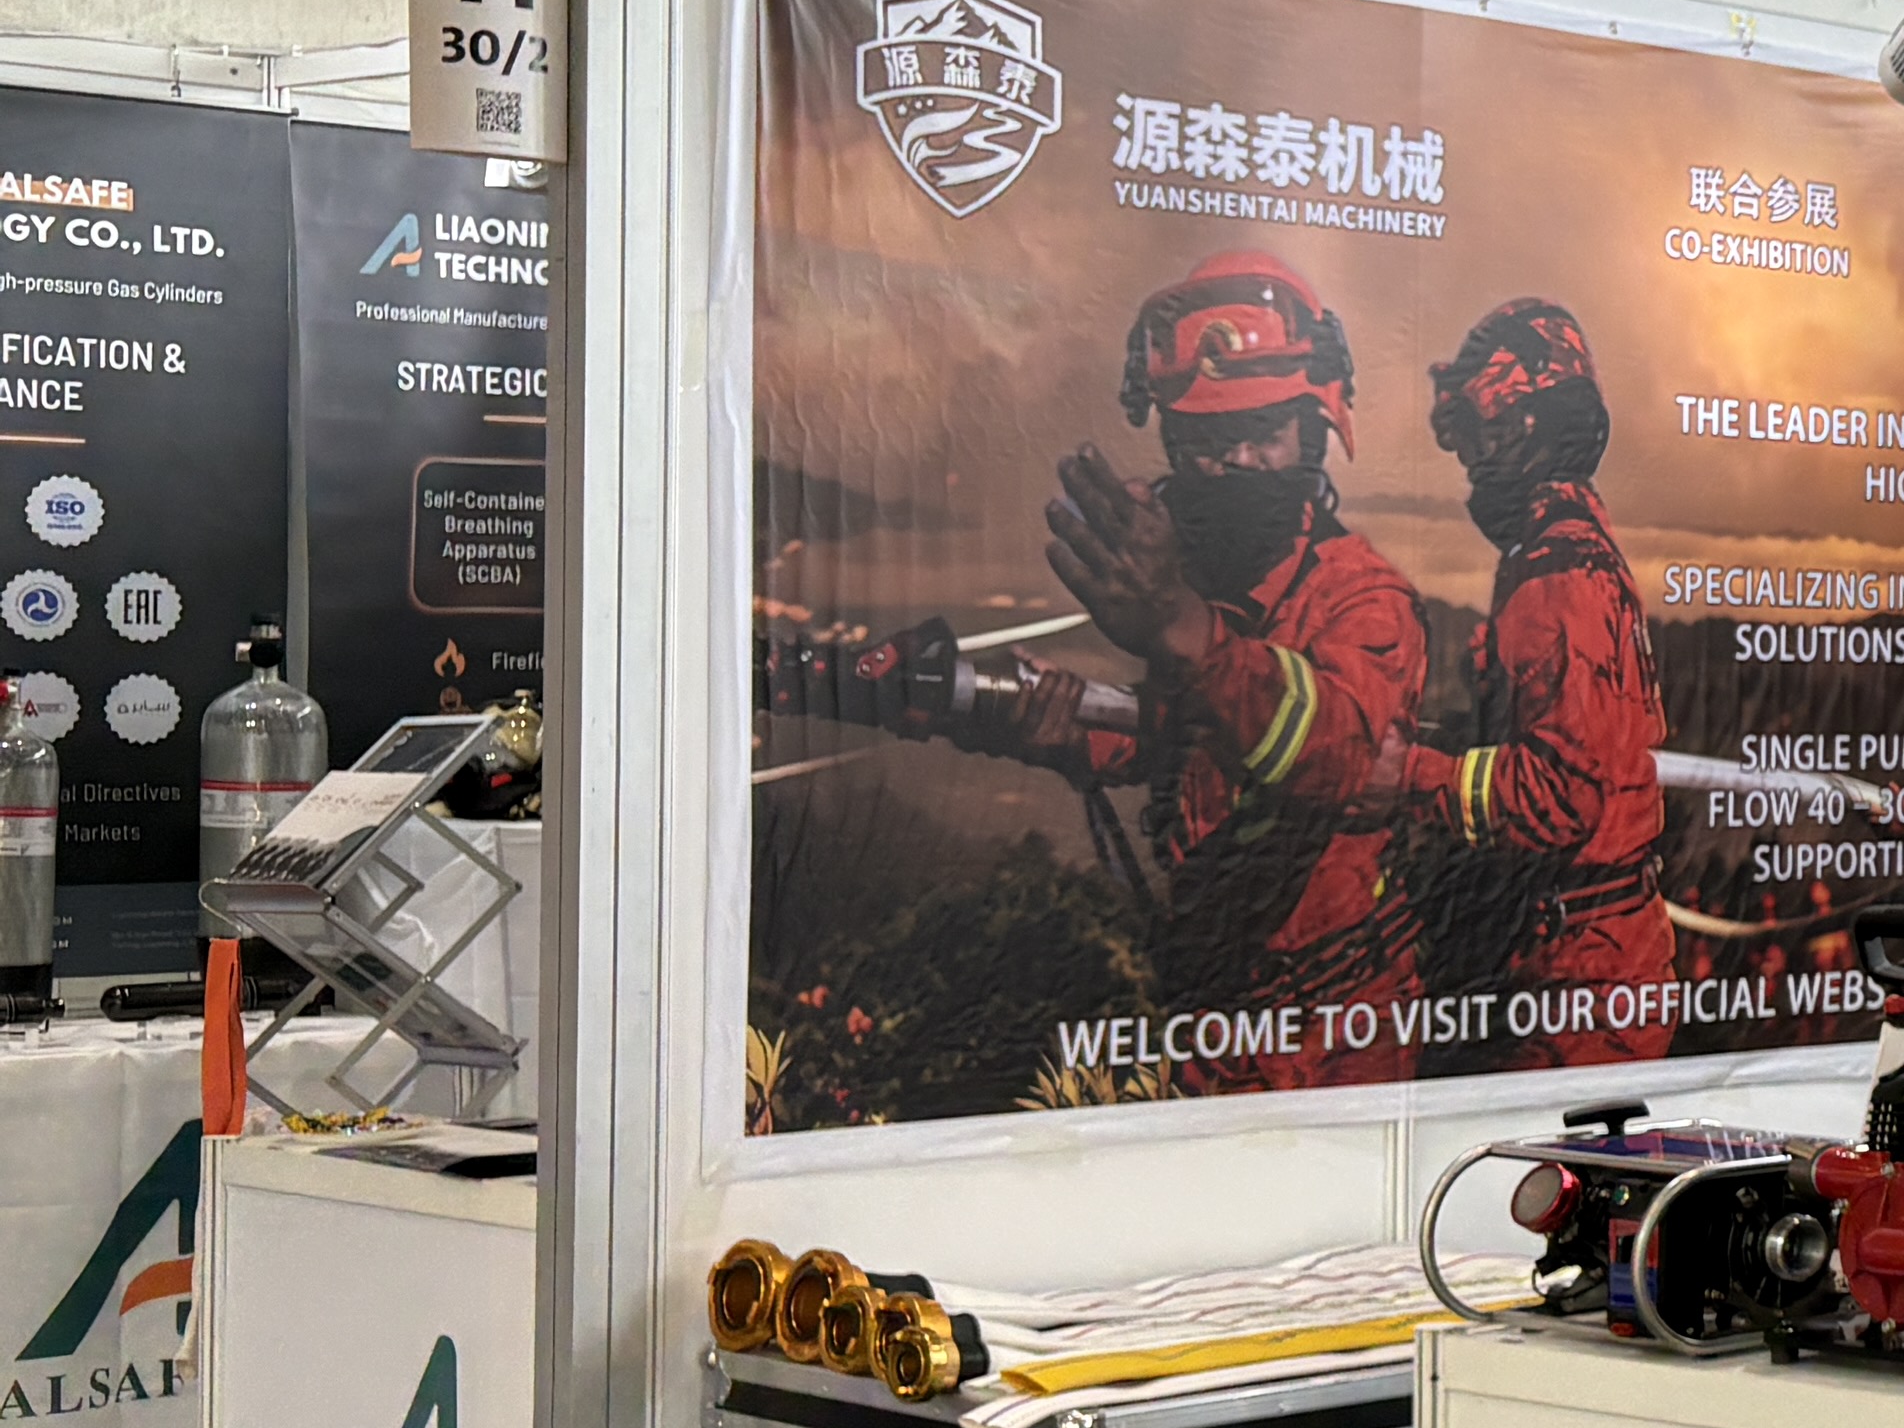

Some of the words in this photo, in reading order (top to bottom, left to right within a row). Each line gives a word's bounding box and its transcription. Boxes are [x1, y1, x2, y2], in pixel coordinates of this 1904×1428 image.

[441, 26, 549, 76] 30/2
[1112, 92, 1445, 204] 源森泰机械
[0, 172, 128, 210] ALSAFE
[1114, 180, 1297, 223] YUANSHENTAI
[1305, 202, 1446, 238] MACHINERY
[1689, 167, 1838, 229] 联合参展
[0, 213, 56, 243] GY
[65, 219, 142, 255] CO.,
[153, 225, 225, 257] LTD.
[1664, 228, 1850, 277] CO-EXHIBITION
[108, 279, 139, 299] Gas
[144, 282, 223, 304] Cylinders
[356, 300, 450, 324] Professional
[2, 333, 153, 372] FICATION
[163, 343, 186, 373] &
[398, 361, 547, 397] STRATEGIC
[1676, 395, 1739, 439] THE
[1749, 402, 1867, 448] LEADER
[45, 500, 85, 515] ISO
[424, 490, 544, 511] Self-Containe
[445, 515, 534, 538] Breathing
[443, 540, 536, 561] Apparatus
[458, 565, 520, 586] (SCBA)
[1664, 566, 1880, 611] SPECIALIZING
[492, 652, 544, 671] Firefi
[1741, 733, 1852, 773] SINGLE
[84, 783, 181, 802] Directives
[1709, 789, 1800, 828] FLOW
[1808, 788, 1845, 824] 40
[65, 824, 141, 842] Markets
[1058, 1008, 1302, 1069] WELCOME
[1314, 1001, 1378, 1049] TO
[1392, 994, 1499, 1045] VISIT
[1507, 988, 1595, 1038] OUR
[1607, 976, 1776, 1030] OFFICIAL
